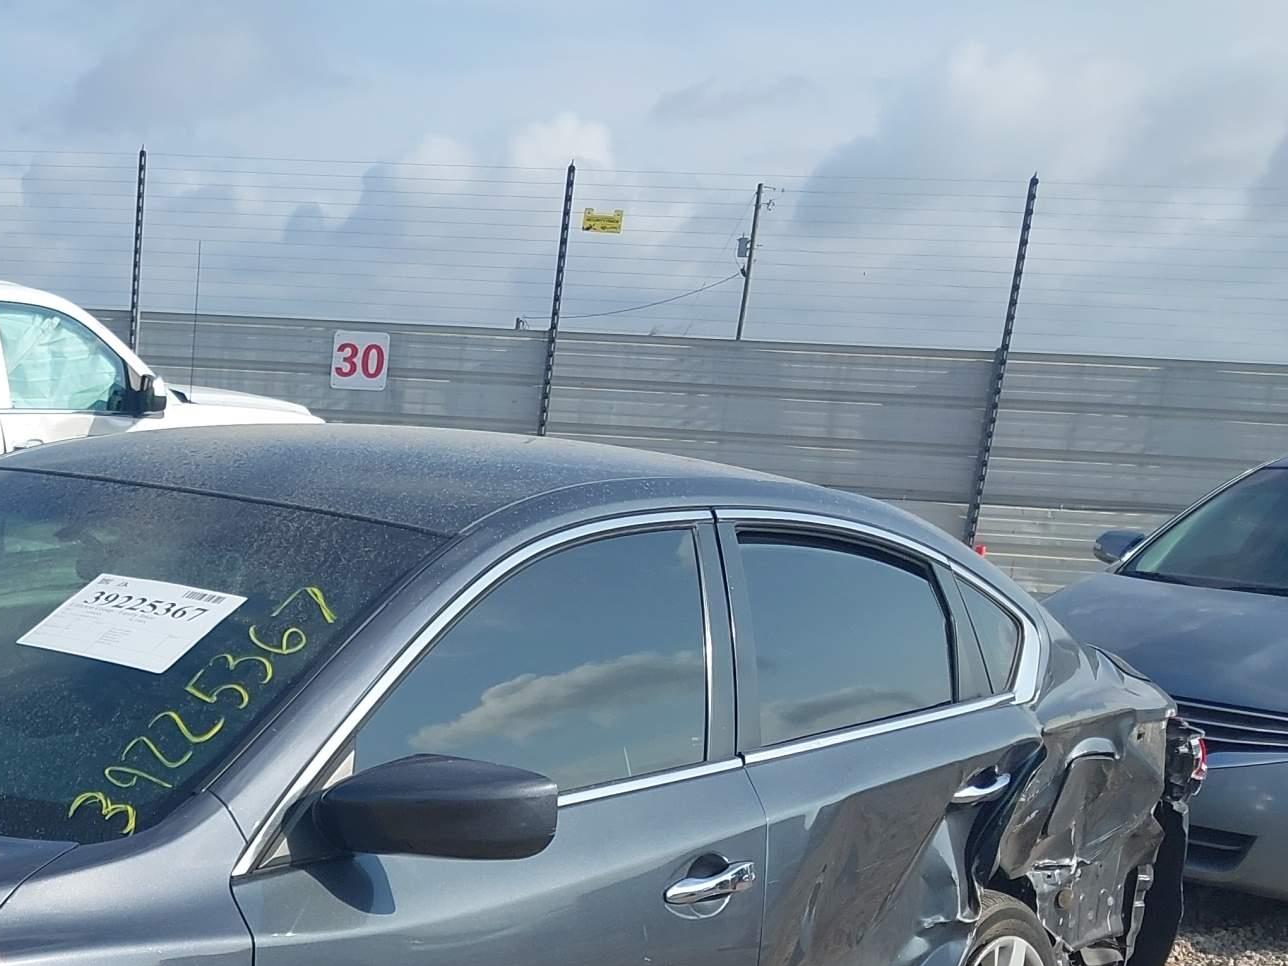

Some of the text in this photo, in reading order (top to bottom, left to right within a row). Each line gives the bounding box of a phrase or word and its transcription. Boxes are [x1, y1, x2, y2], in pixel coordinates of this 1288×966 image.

[334, 342, 385, 379] 30
[83, 590, 210, 622] 39225367
[68, 586, 337, 836] 39225367
